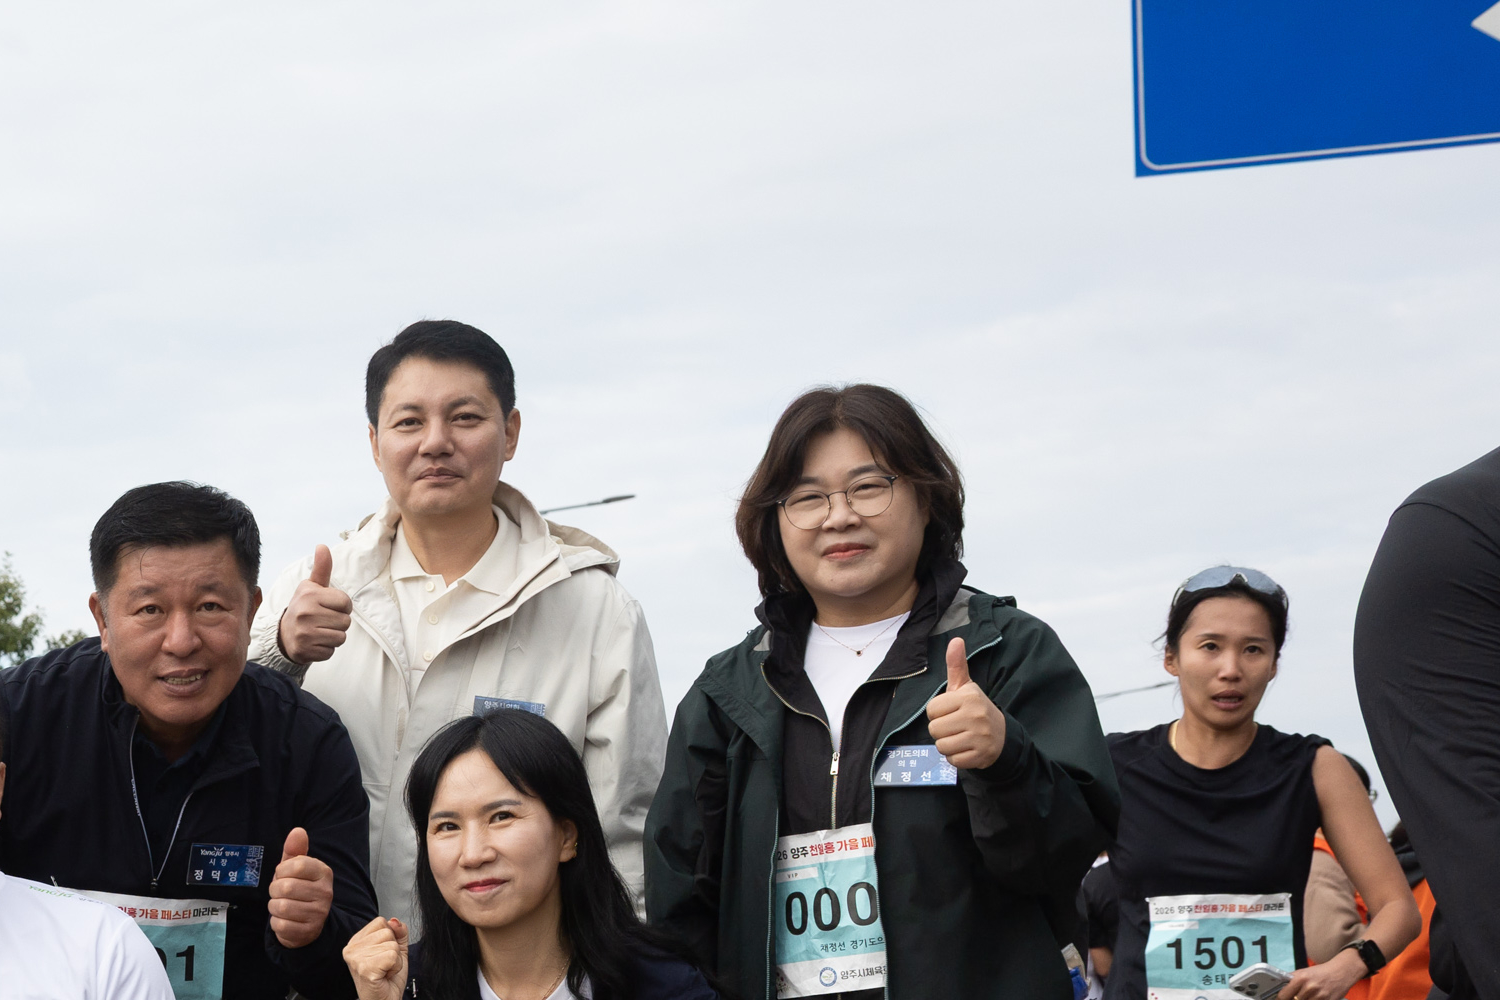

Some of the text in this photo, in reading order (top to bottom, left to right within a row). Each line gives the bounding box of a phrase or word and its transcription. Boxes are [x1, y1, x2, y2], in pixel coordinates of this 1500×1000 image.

[887, 749, 929, 759] 경기도의회
[897, 759, 917, 767] 의원
[880, 770, 932, 783] 채정선
[790, 846, 810, 860] 양주
[809, 841, 835, 857] 천일홍
[837, 838, 859, 852] 가을
[209, 858, 228, 867] 시장
[193, 869, 238, 882] 정덕영
[138, 908, 159, 920] 가을
[160, 907, 192, 921] 페스타
[1155, 906, 1175, 915] 2026
[1177, 905, 1193, 914] 양주
[1219, 903, 1237, 913] 가을
[1238, 903, 1263, 913] 페스타
[820, 941, 846, 953] 채정선
[1166, 935, 1269, 970] 1501
[1201, 973, 1234, 986] 송태
